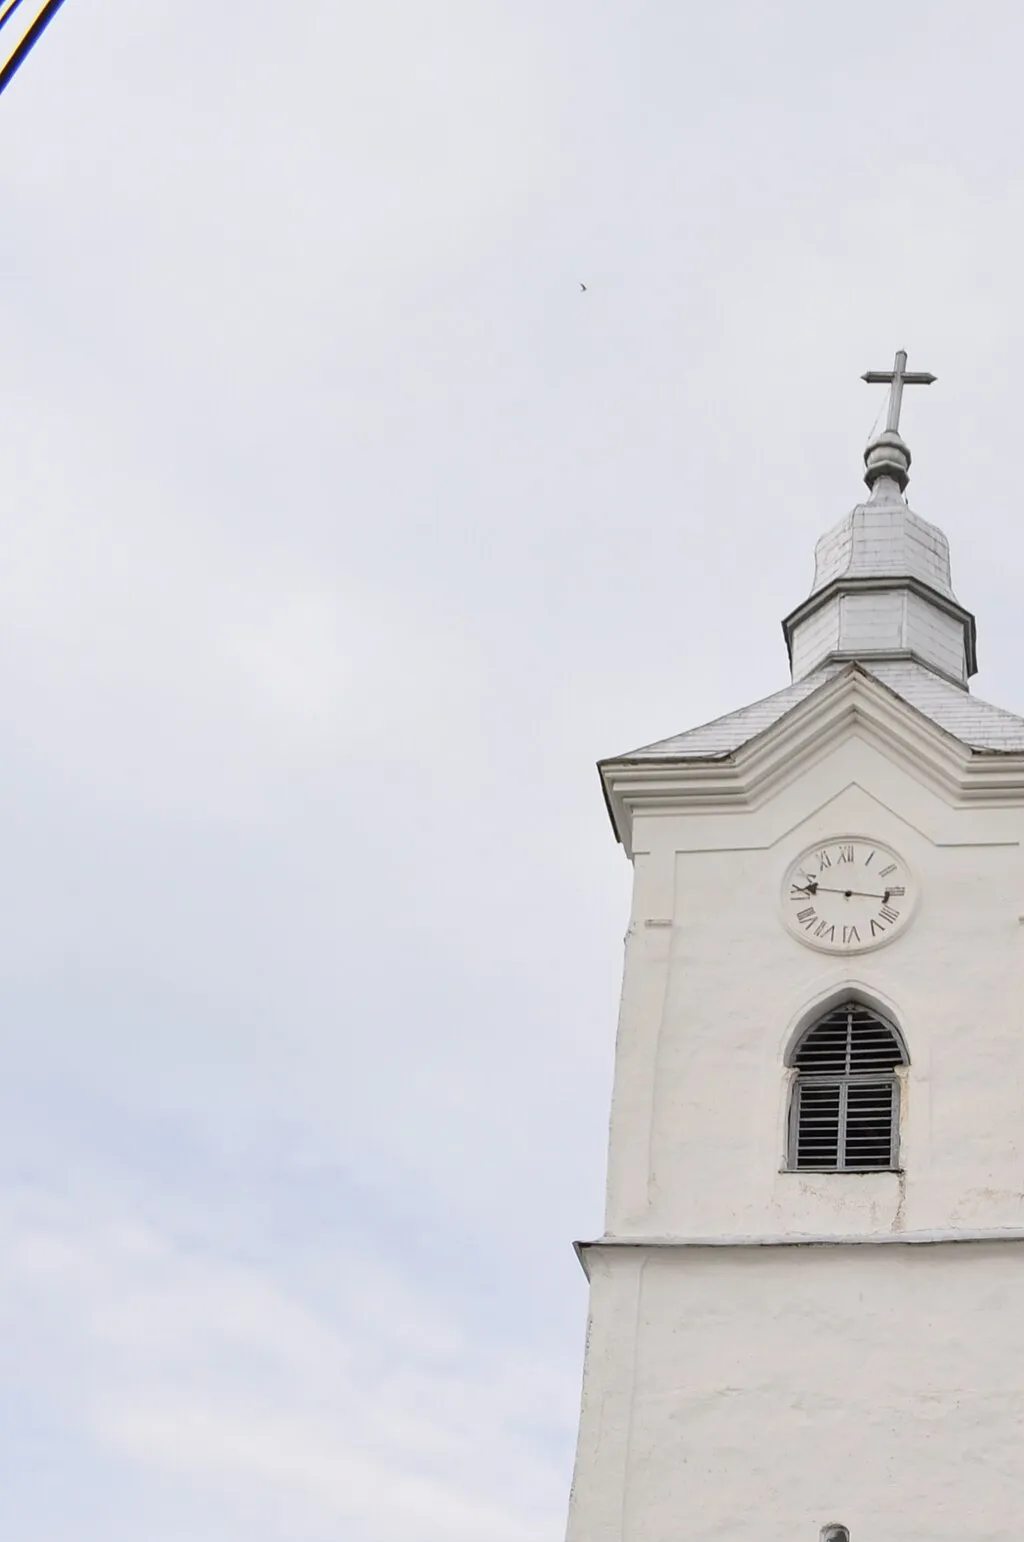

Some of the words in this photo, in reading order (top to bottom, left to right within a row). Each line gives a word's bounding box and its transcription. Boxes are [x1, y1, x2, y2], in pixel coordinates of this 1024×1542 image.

[815, 850, 832, 871] XI
[837, 845, 854, 864] XII
[878, 863, 898, 878] II
[870, 918, 886, 937] V
